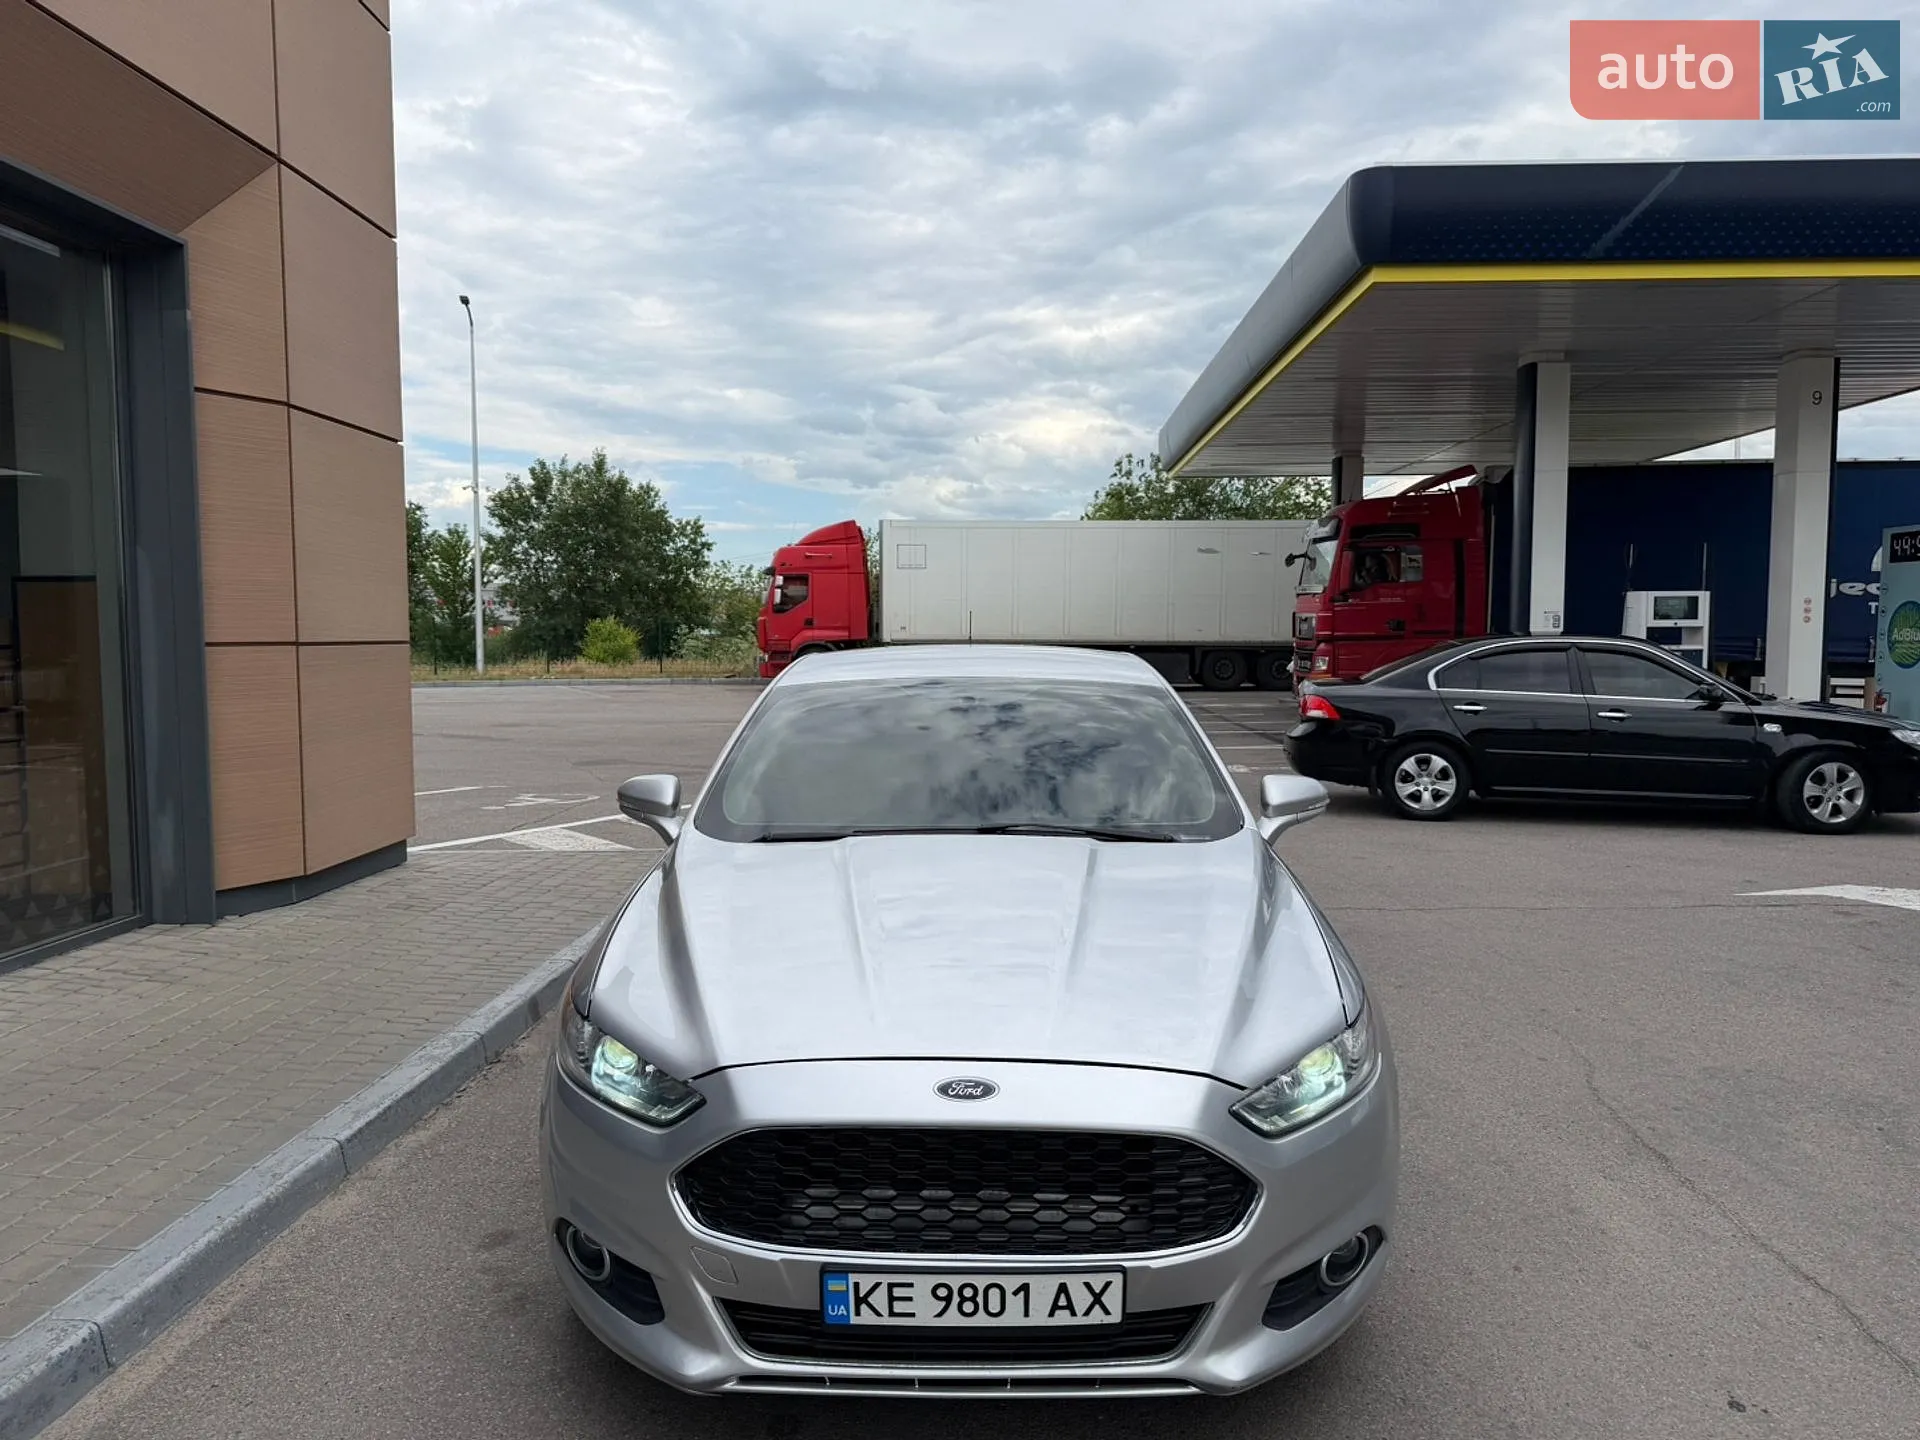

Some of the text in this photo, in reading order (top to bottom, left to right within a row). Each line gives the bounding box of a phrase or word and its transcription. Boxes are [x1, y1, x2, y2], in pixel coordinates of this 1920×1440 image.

[1812, 390, 1823, 406] 9
[1892, 627, 1920, 641] AdBlu
[948, 1081, 984, 1096] Ford
[853, 1280, 1113, 1318] KE 9801 AX
[828, 1304, 848, 1316] UA
